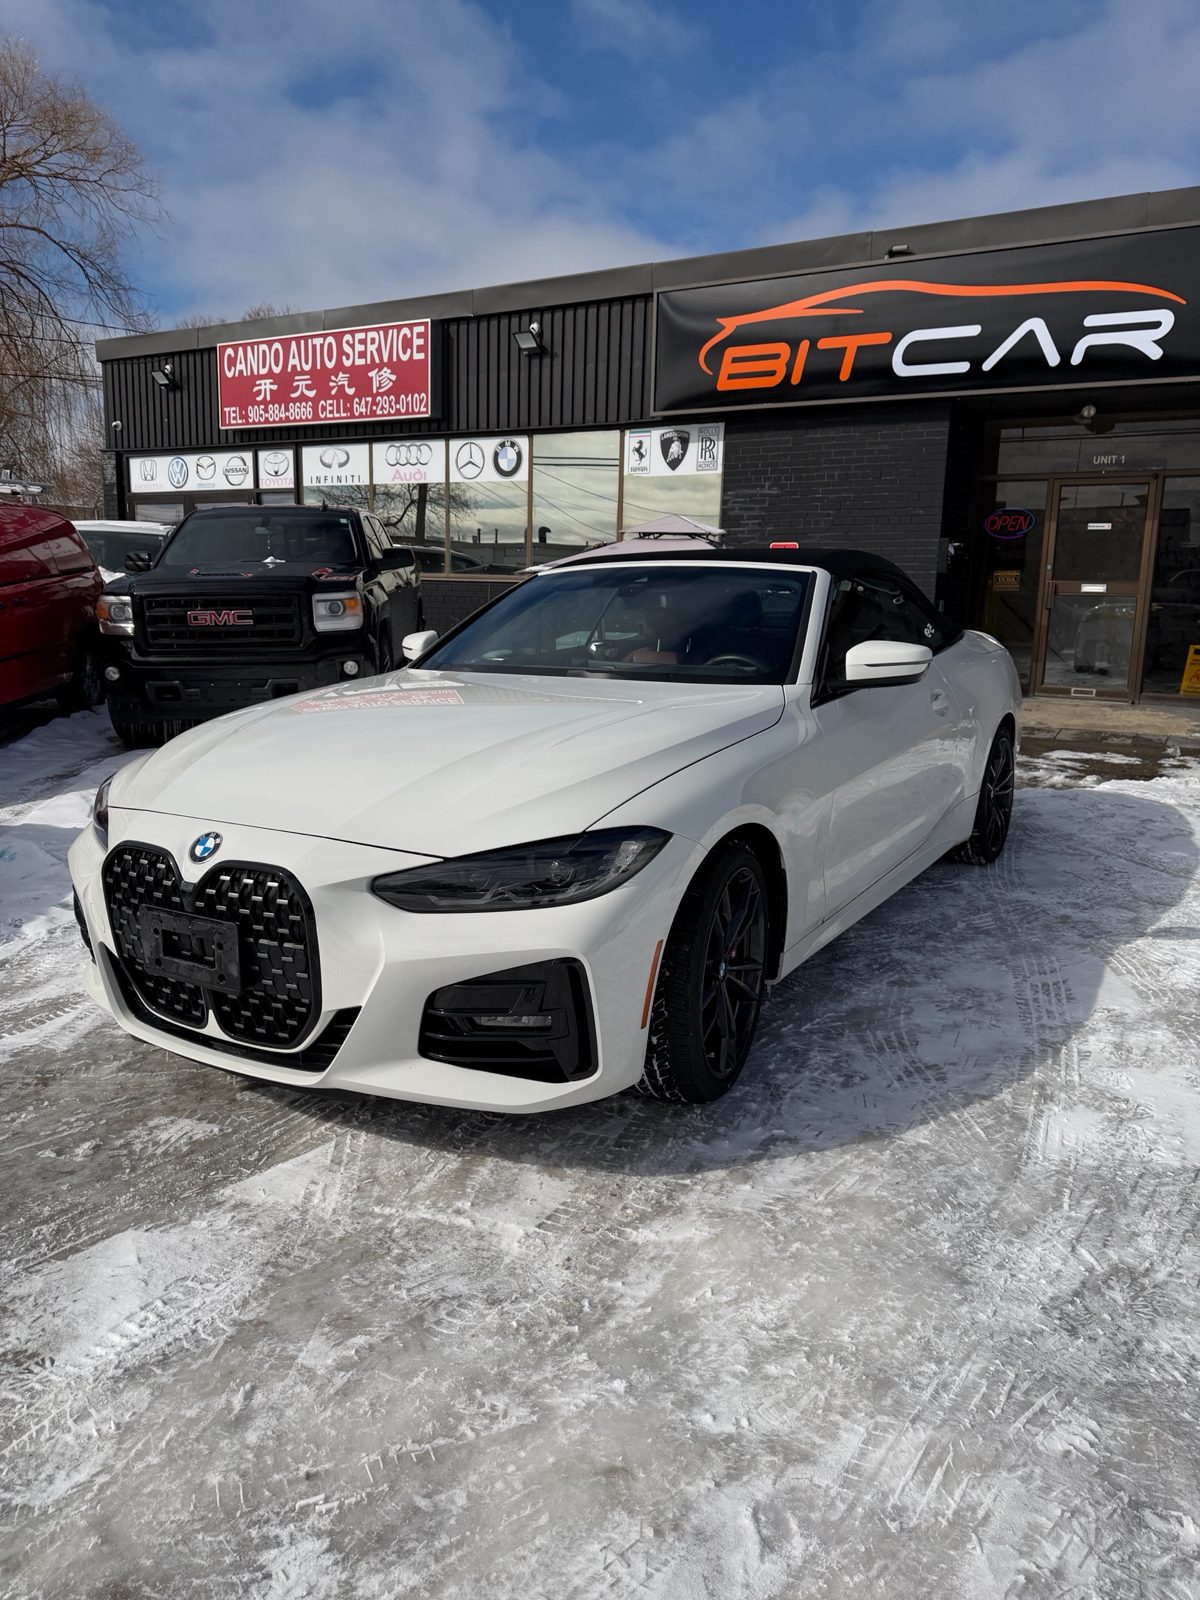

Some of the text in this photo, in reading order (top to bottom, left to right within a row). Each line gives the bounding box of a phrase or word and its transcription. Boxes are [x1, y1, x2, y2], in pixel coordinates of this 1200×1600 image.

[223, 325, 425, 378] CANDO AUTO SERVICE
[716, 308, 1175, 392] BITCAR
[223, 392, 427, 425] TEL: 905-884-8666 CELL: 647-293-0102
[1093, 455, 1126, 464] UNIT 1
[260, 477, 294, 487] TOYOTA
[310, 474, 361, 485] INFINITI
[391, 467, 427, 482] Audi
[987, 514, 1031, 532] OPEN
[187, 609, 254, 626] GMC
